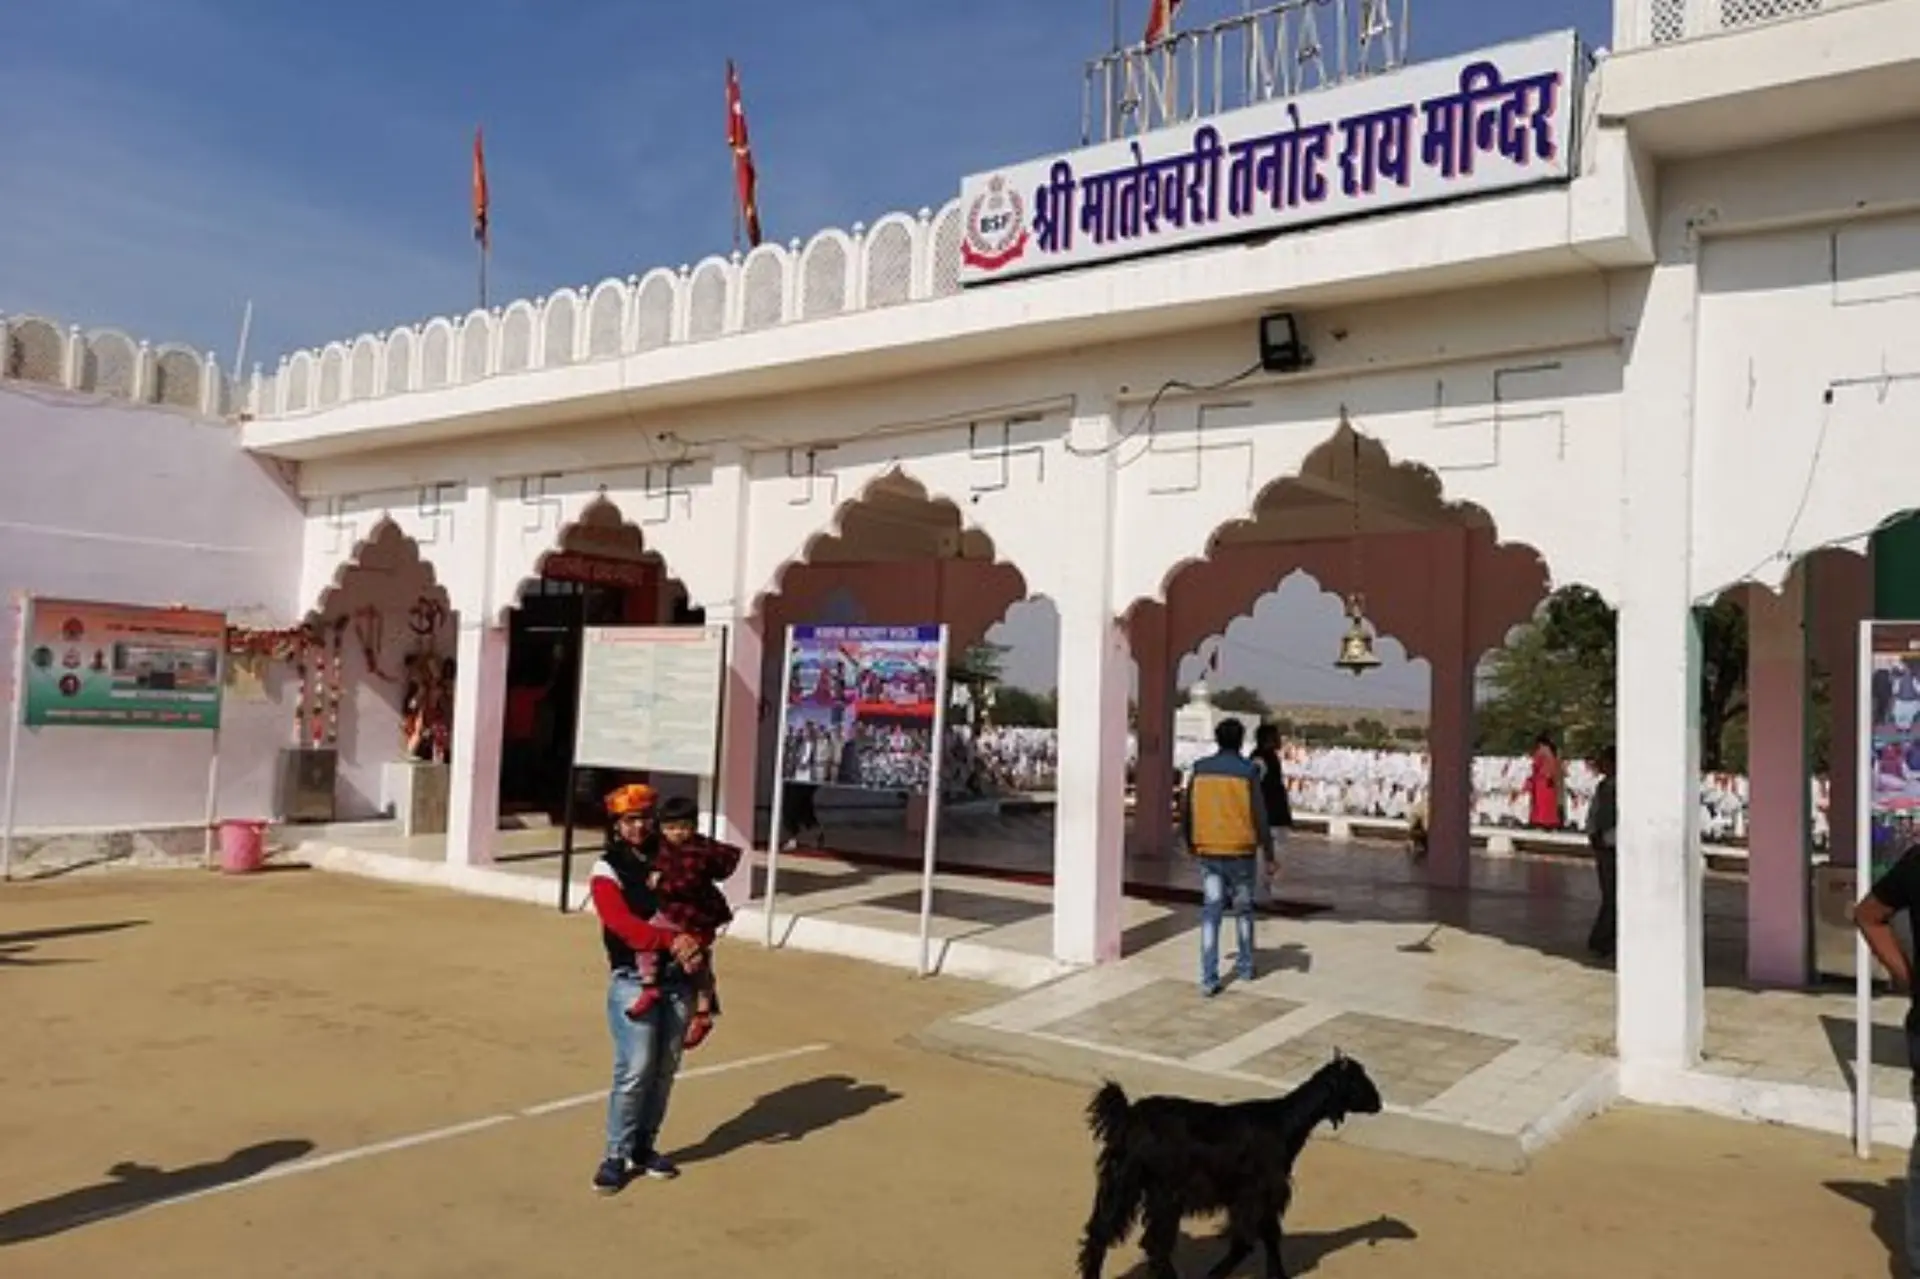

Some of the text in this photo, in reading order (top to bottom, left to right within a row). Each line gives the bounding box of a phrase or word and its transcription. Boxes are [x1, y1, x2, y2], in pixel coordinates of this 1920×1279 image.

[1033, 61, 1562, 252] श्री मातेश्वरी तनोट राय मन्दिर
[980, 211, 1013, 233] BSF
